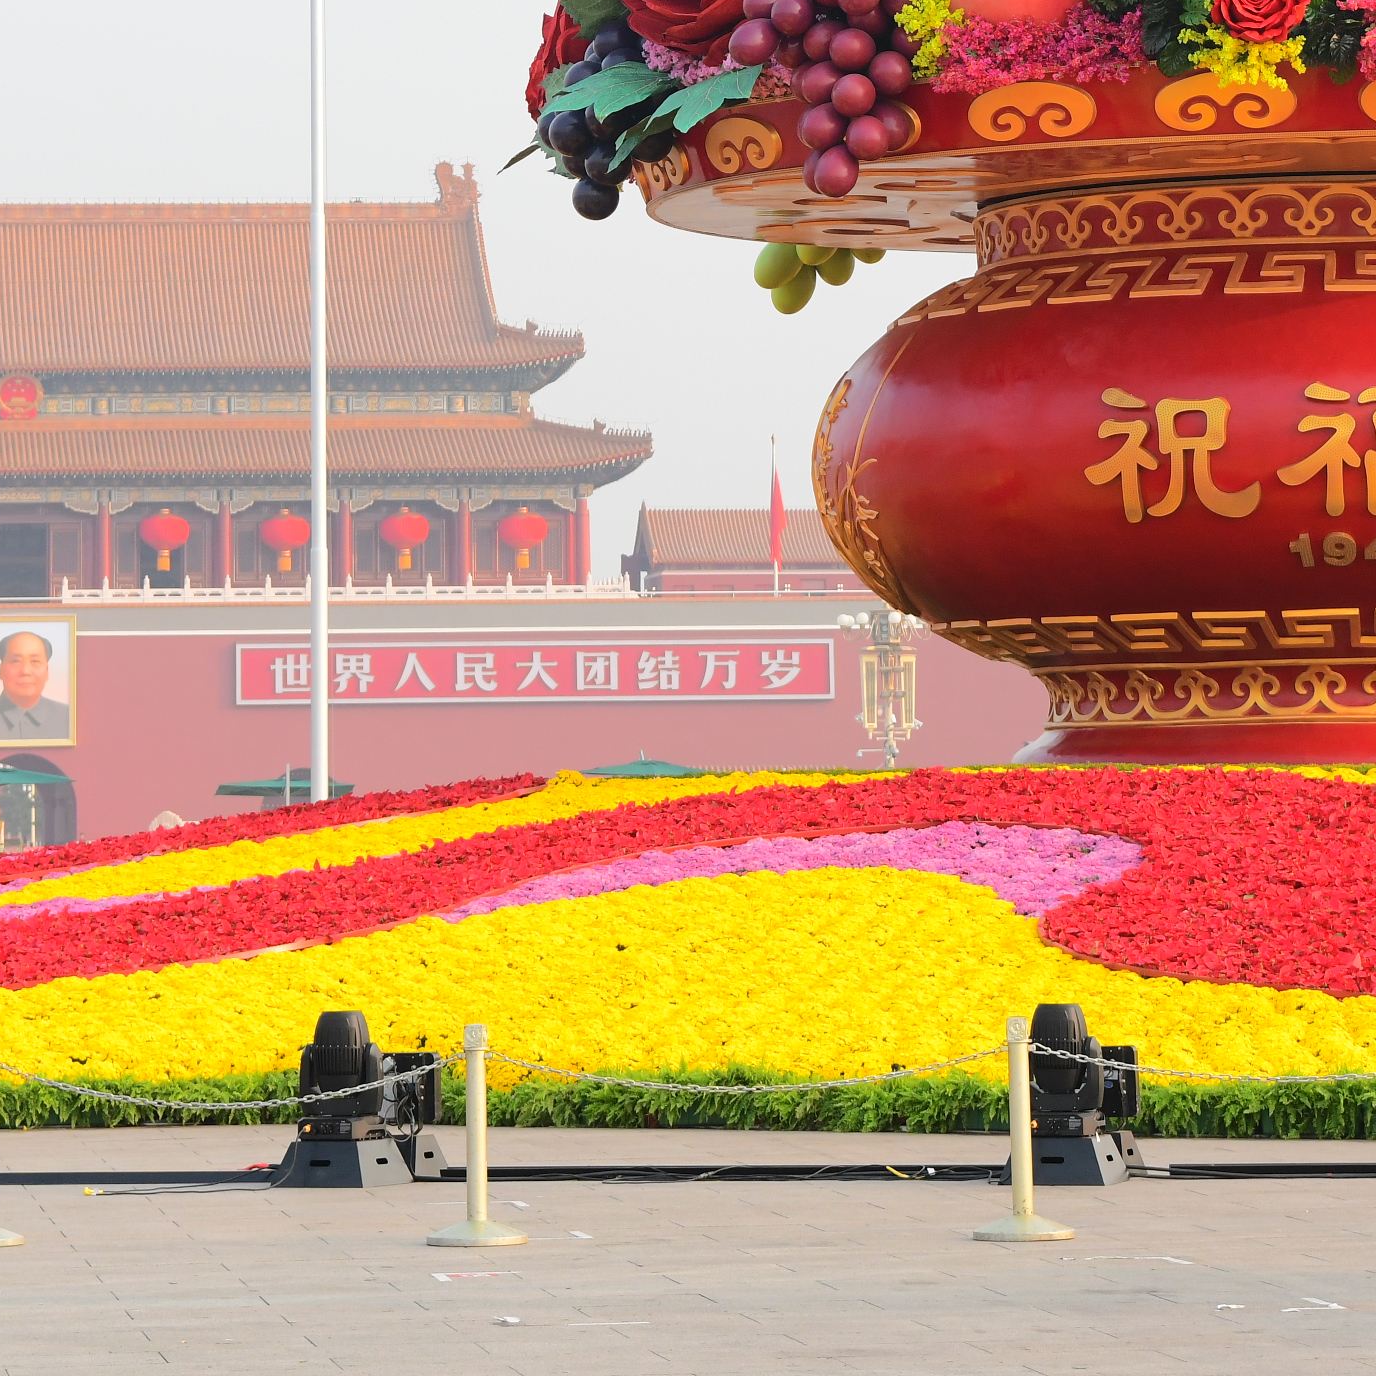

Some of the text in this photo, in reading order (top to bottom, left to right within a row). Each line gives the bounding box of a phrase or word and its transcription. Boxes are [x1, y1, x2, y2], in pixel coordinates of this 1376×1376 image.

[270, 649, 803, 694] 世界人民大团结万岁
